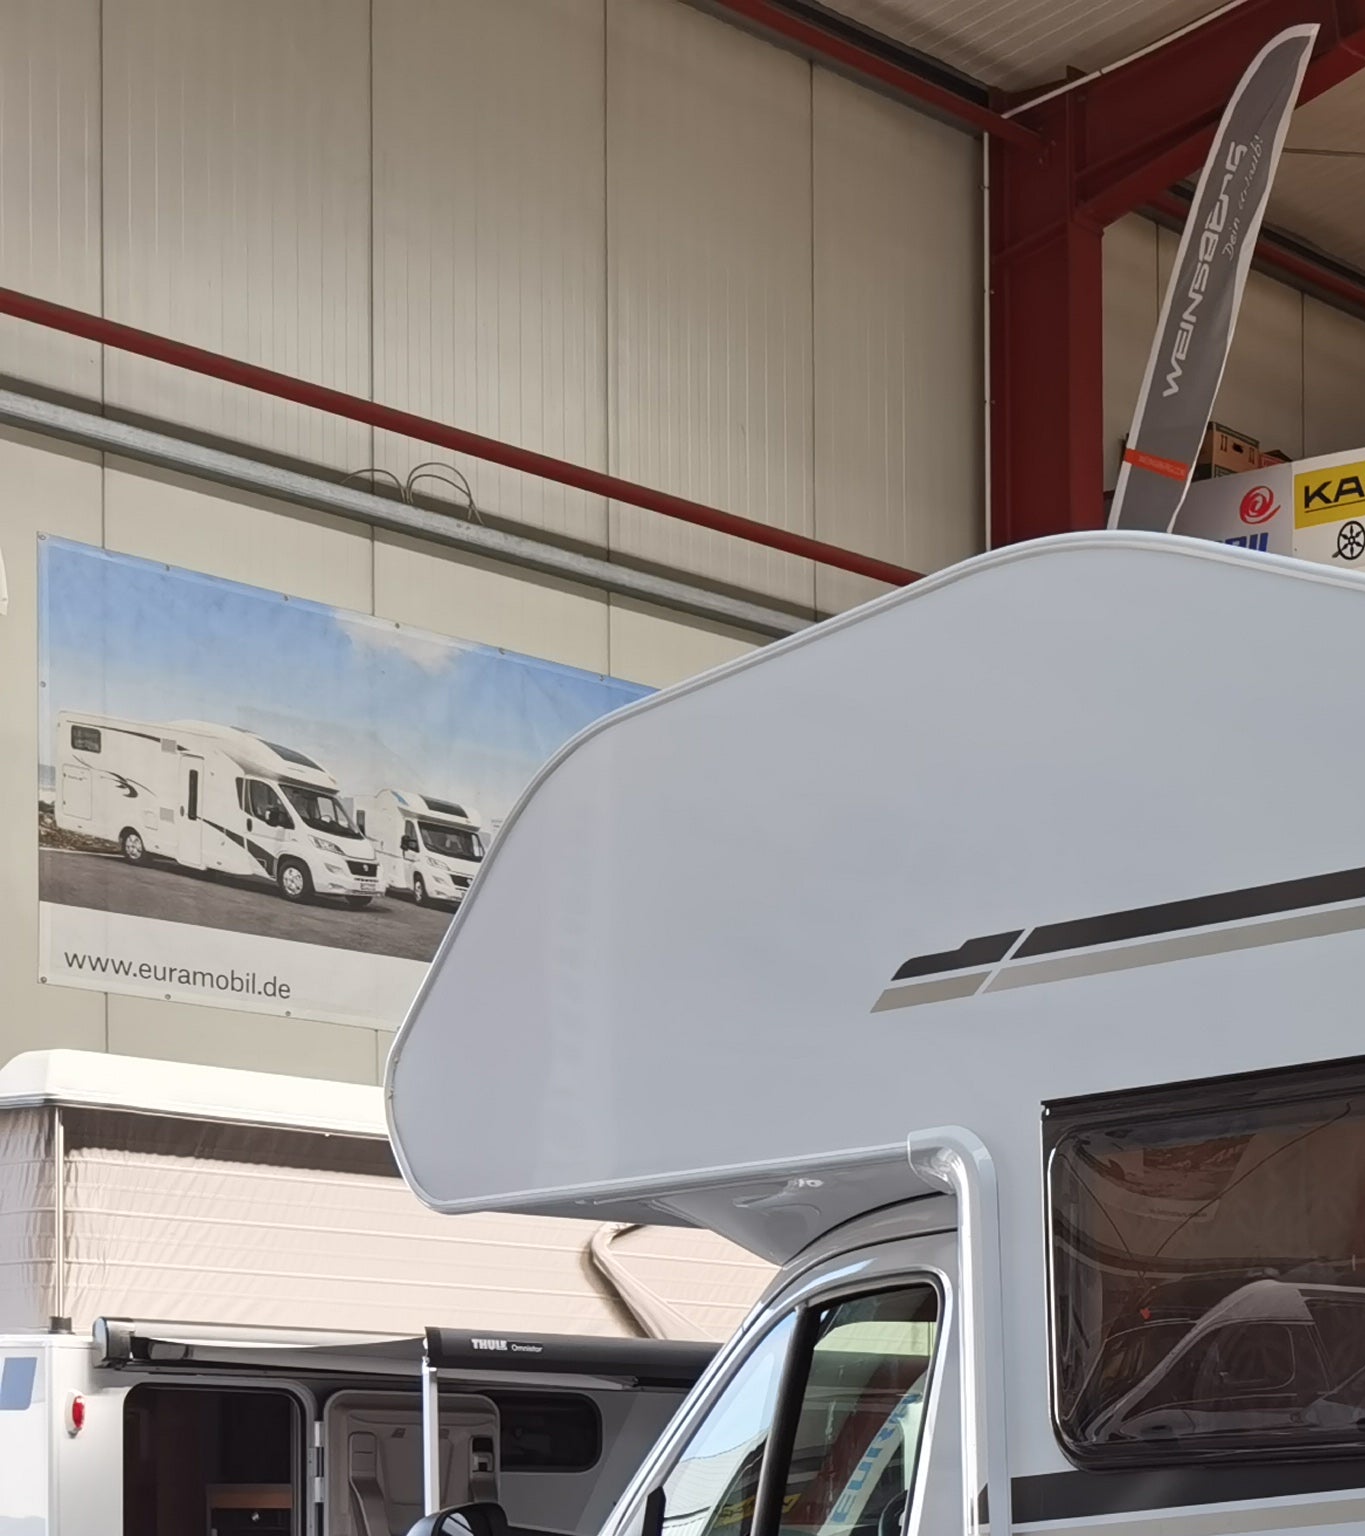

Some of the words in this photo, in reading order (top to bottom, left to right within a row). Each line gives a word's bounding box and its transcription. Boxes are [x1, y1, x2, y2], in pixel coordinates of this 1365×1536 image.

[1221, 217, 1240, 261] Dein
[1163, 141, 1248, 397] WEINSBERG
[64, 951, 292, 999] www.euramobil.de
[470, 1338, 508, 1351] THULE
